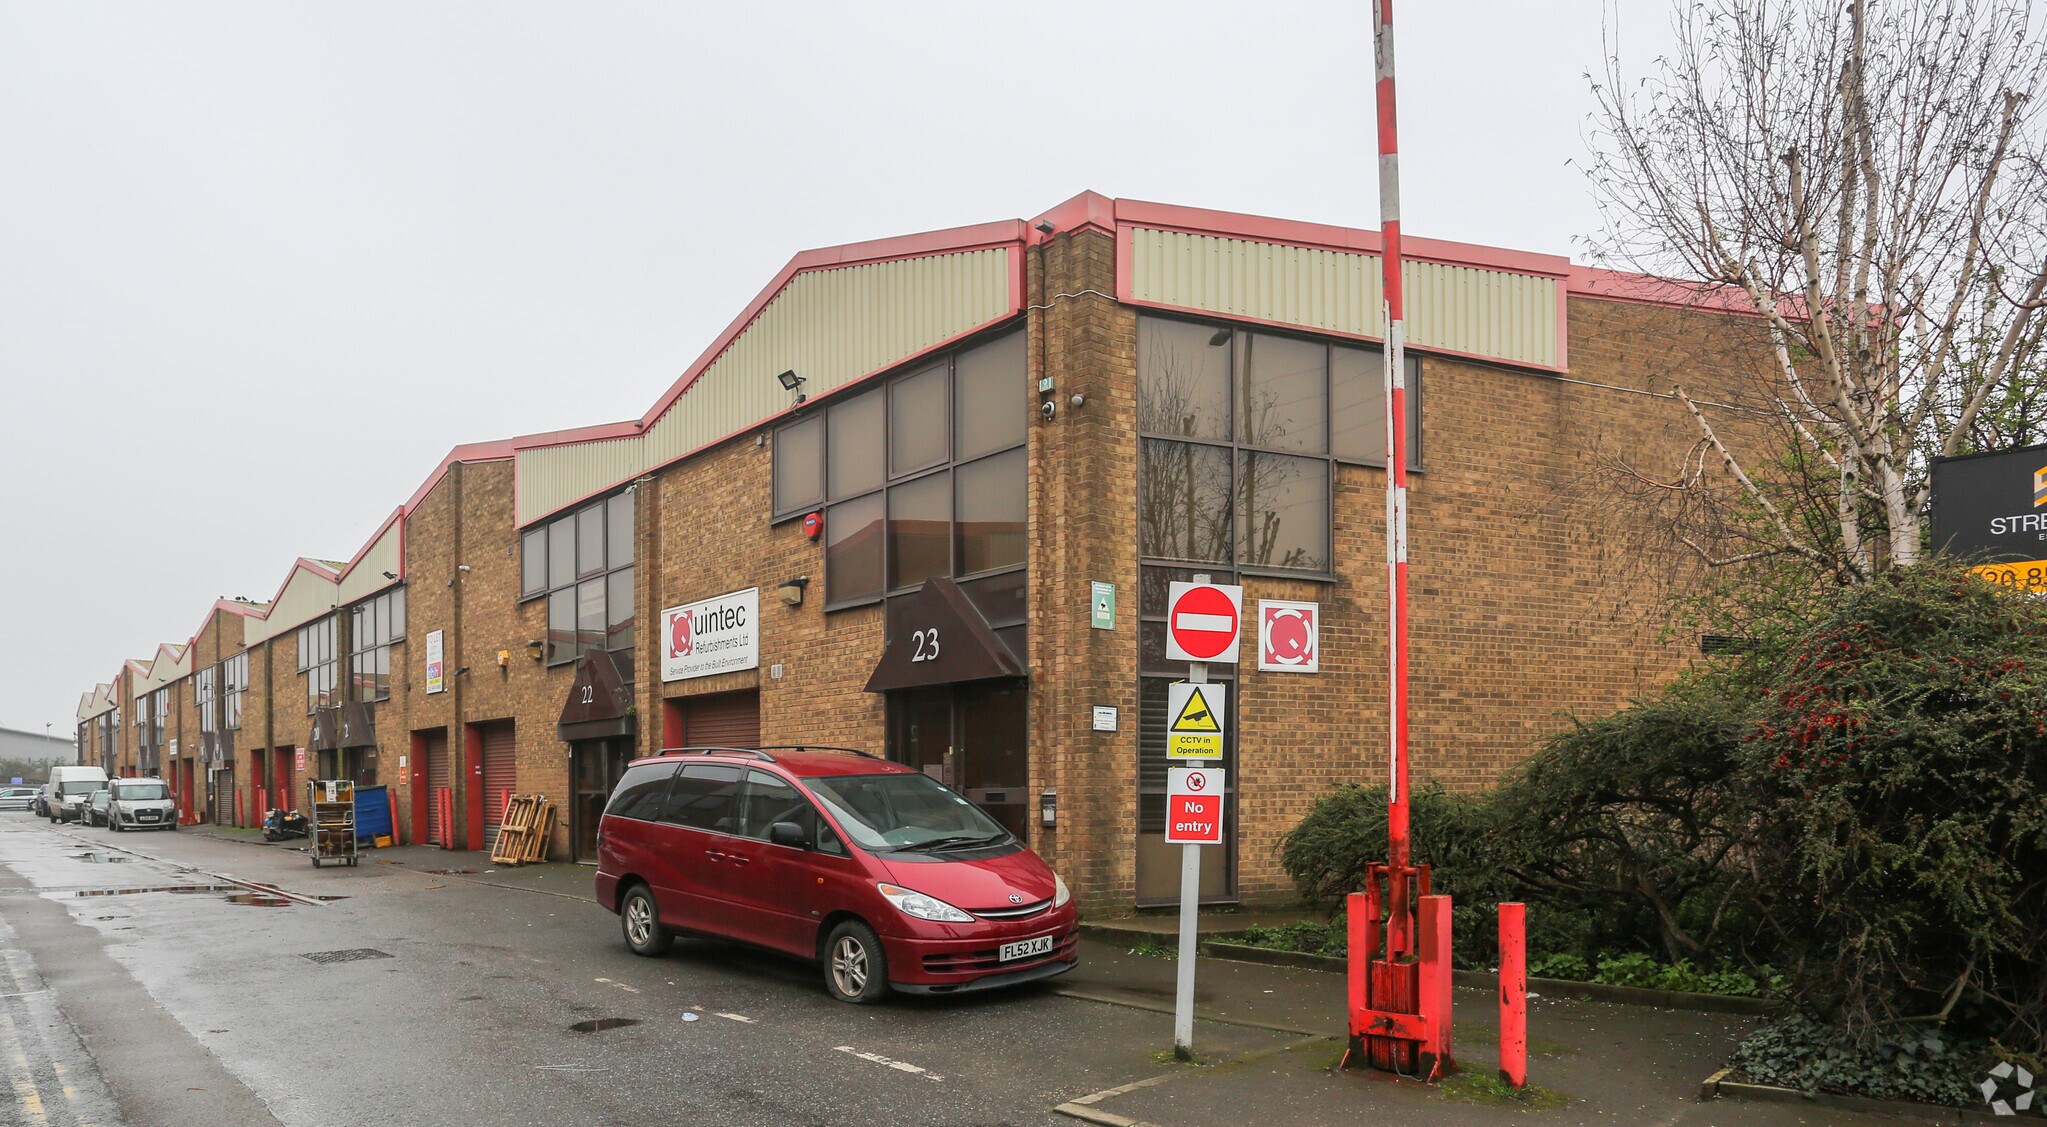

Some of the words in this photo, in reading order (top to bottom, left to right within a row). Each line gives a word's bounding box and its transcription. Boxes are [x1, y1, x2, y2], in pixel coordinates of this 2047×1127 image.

[2027, 567, 2047, 587] 8
[696, 636, 738, 654] Refurbishments
[739, 632, 749, 648] Ltd
[912, 628, 940, 663] 23
[669, 667, 684, 676] Service
[684, 663, 700, 675] Provider
[712, 659, 721, 669] Built
[722, 656, 749, 668] Environment
[582, 685, 593, 704] 22
[1180, 736, 1202, 744] CCTV
[1176, 746, 1214, 755] Operation
[1185, 801, 1204, 813] No
[1176, 820, 1212, 835] entry
[1005, 943, 1029, 958] FL52
[1032, 938, 1049, 953] XJK
